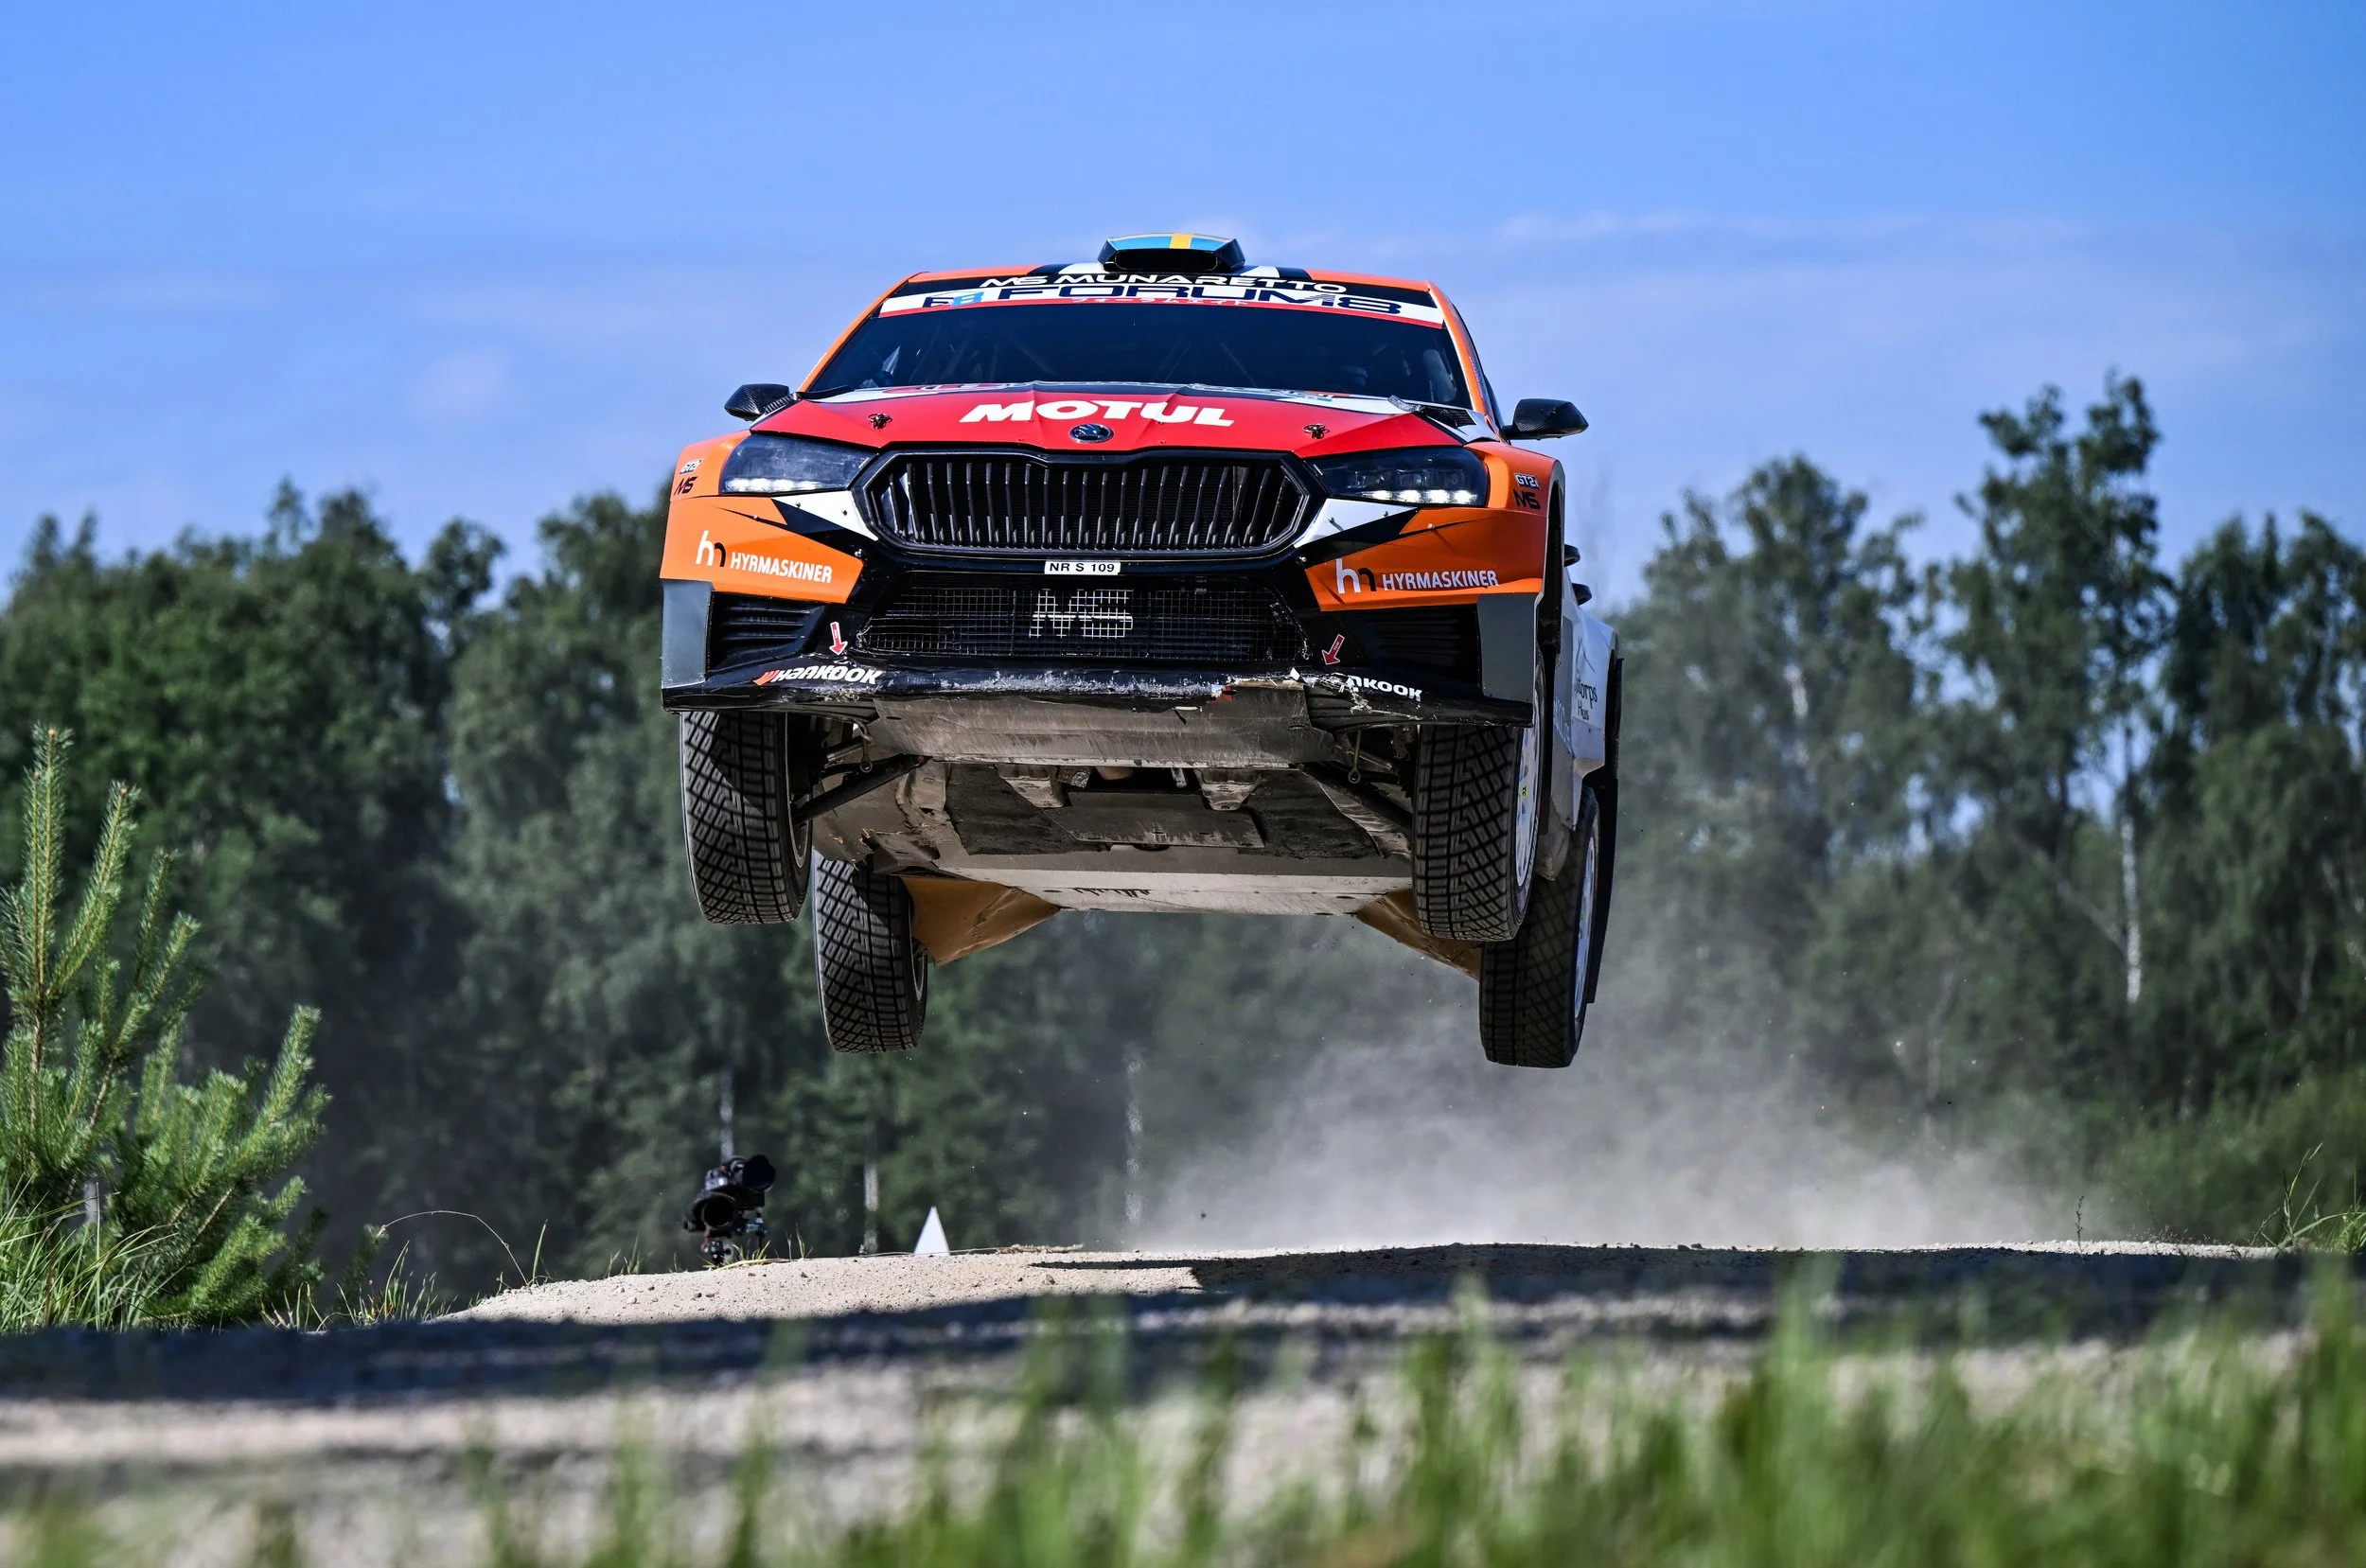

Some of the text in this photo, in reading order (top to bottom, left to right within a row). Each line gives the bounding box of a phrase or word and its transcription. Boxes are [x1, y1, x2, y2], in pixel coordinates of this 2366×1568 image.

[980, 274, 1347, 293] MS MUNARETTO
[998, 285, 1402, 315] FORUM8
[959, 400, 1234, 427] MOTUL
[730, 552, 833, 584] HYRMASKINER
[1050, 562, 1115, 573] NR S 109
[1382, 570, 1499, 591] HYRMASKINER
